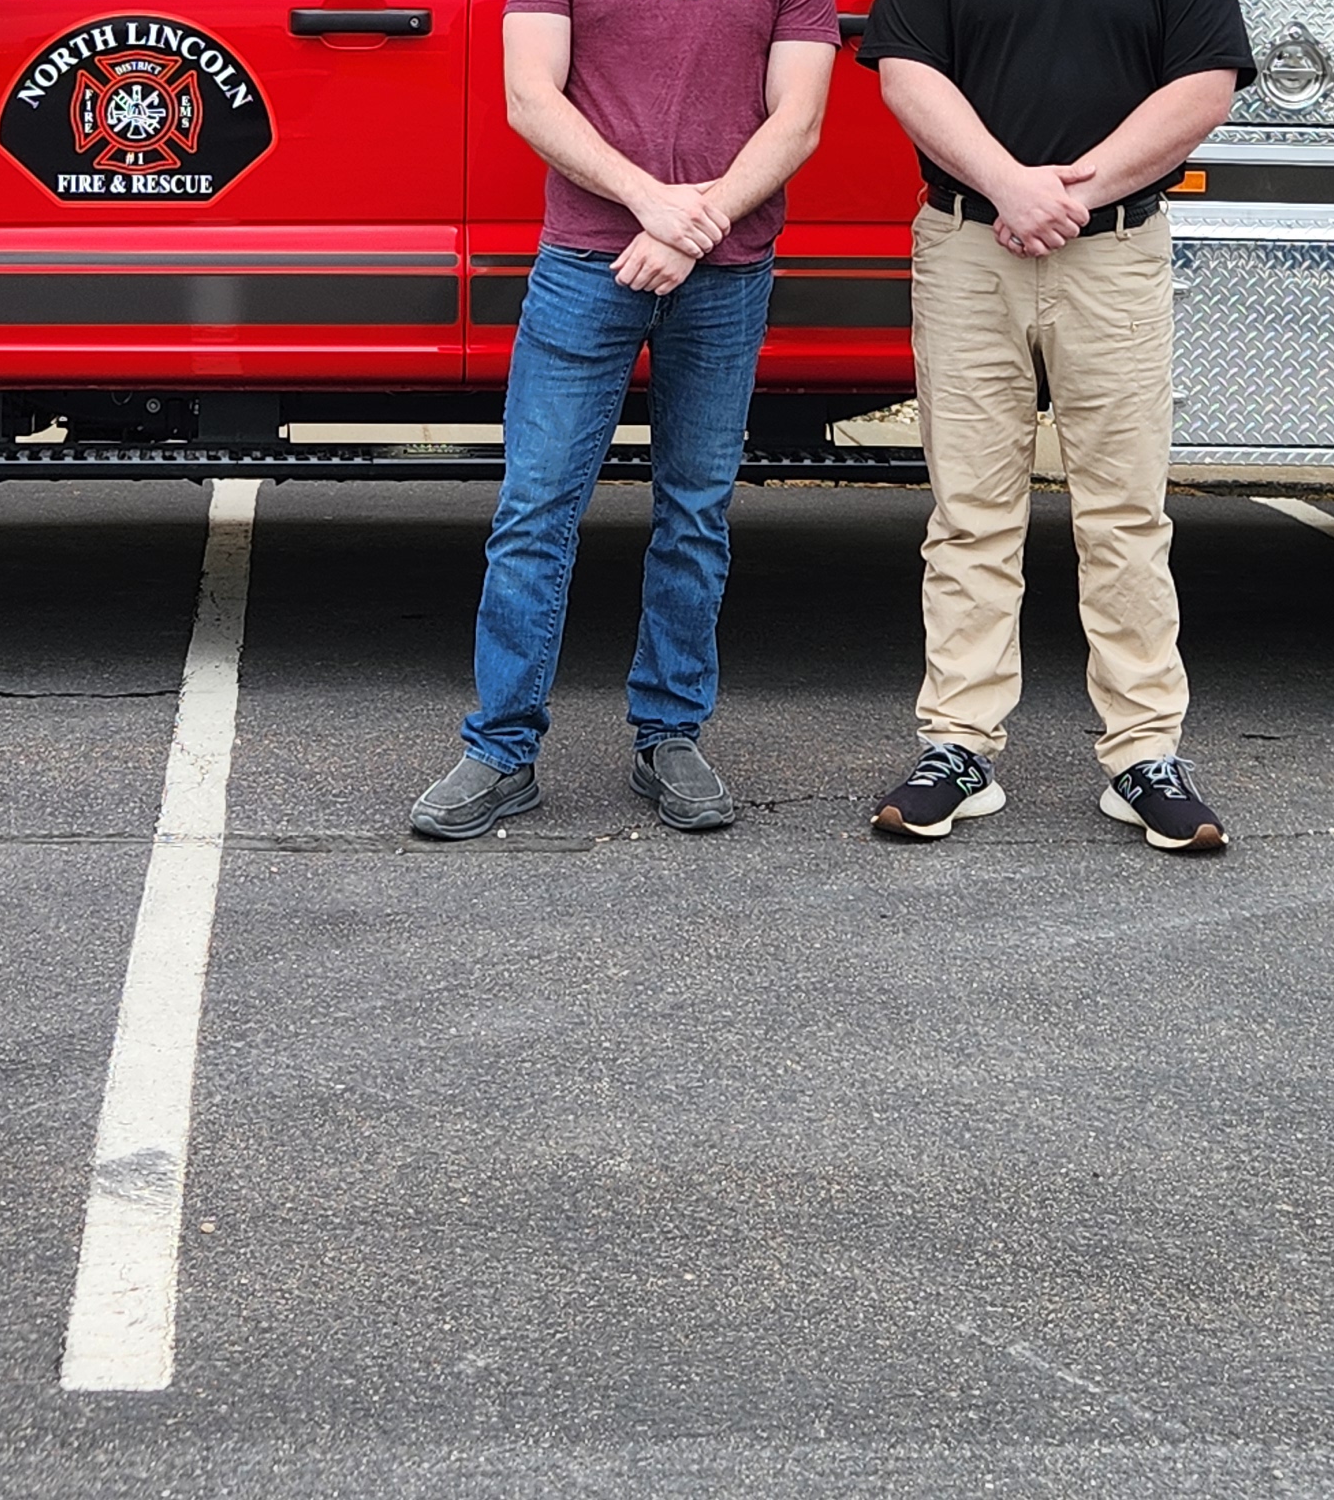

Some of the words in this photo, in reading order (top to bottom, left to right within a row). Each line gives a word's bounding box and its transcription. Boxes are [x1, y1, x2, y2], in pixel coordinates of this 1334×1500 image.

[17, 24, 118, 110] NORTH
[125, 22, 254, 110] LINCOLN
[114, 61, 163, 76] DISTRICT
[83, 88, 95, 134] FIRE
[179, 95, 193, 129] EMS
[57, 174, 106, 194] FIRE
[109, 174, 127, 194] &
[131, 174, 213, 194] RESCUE
